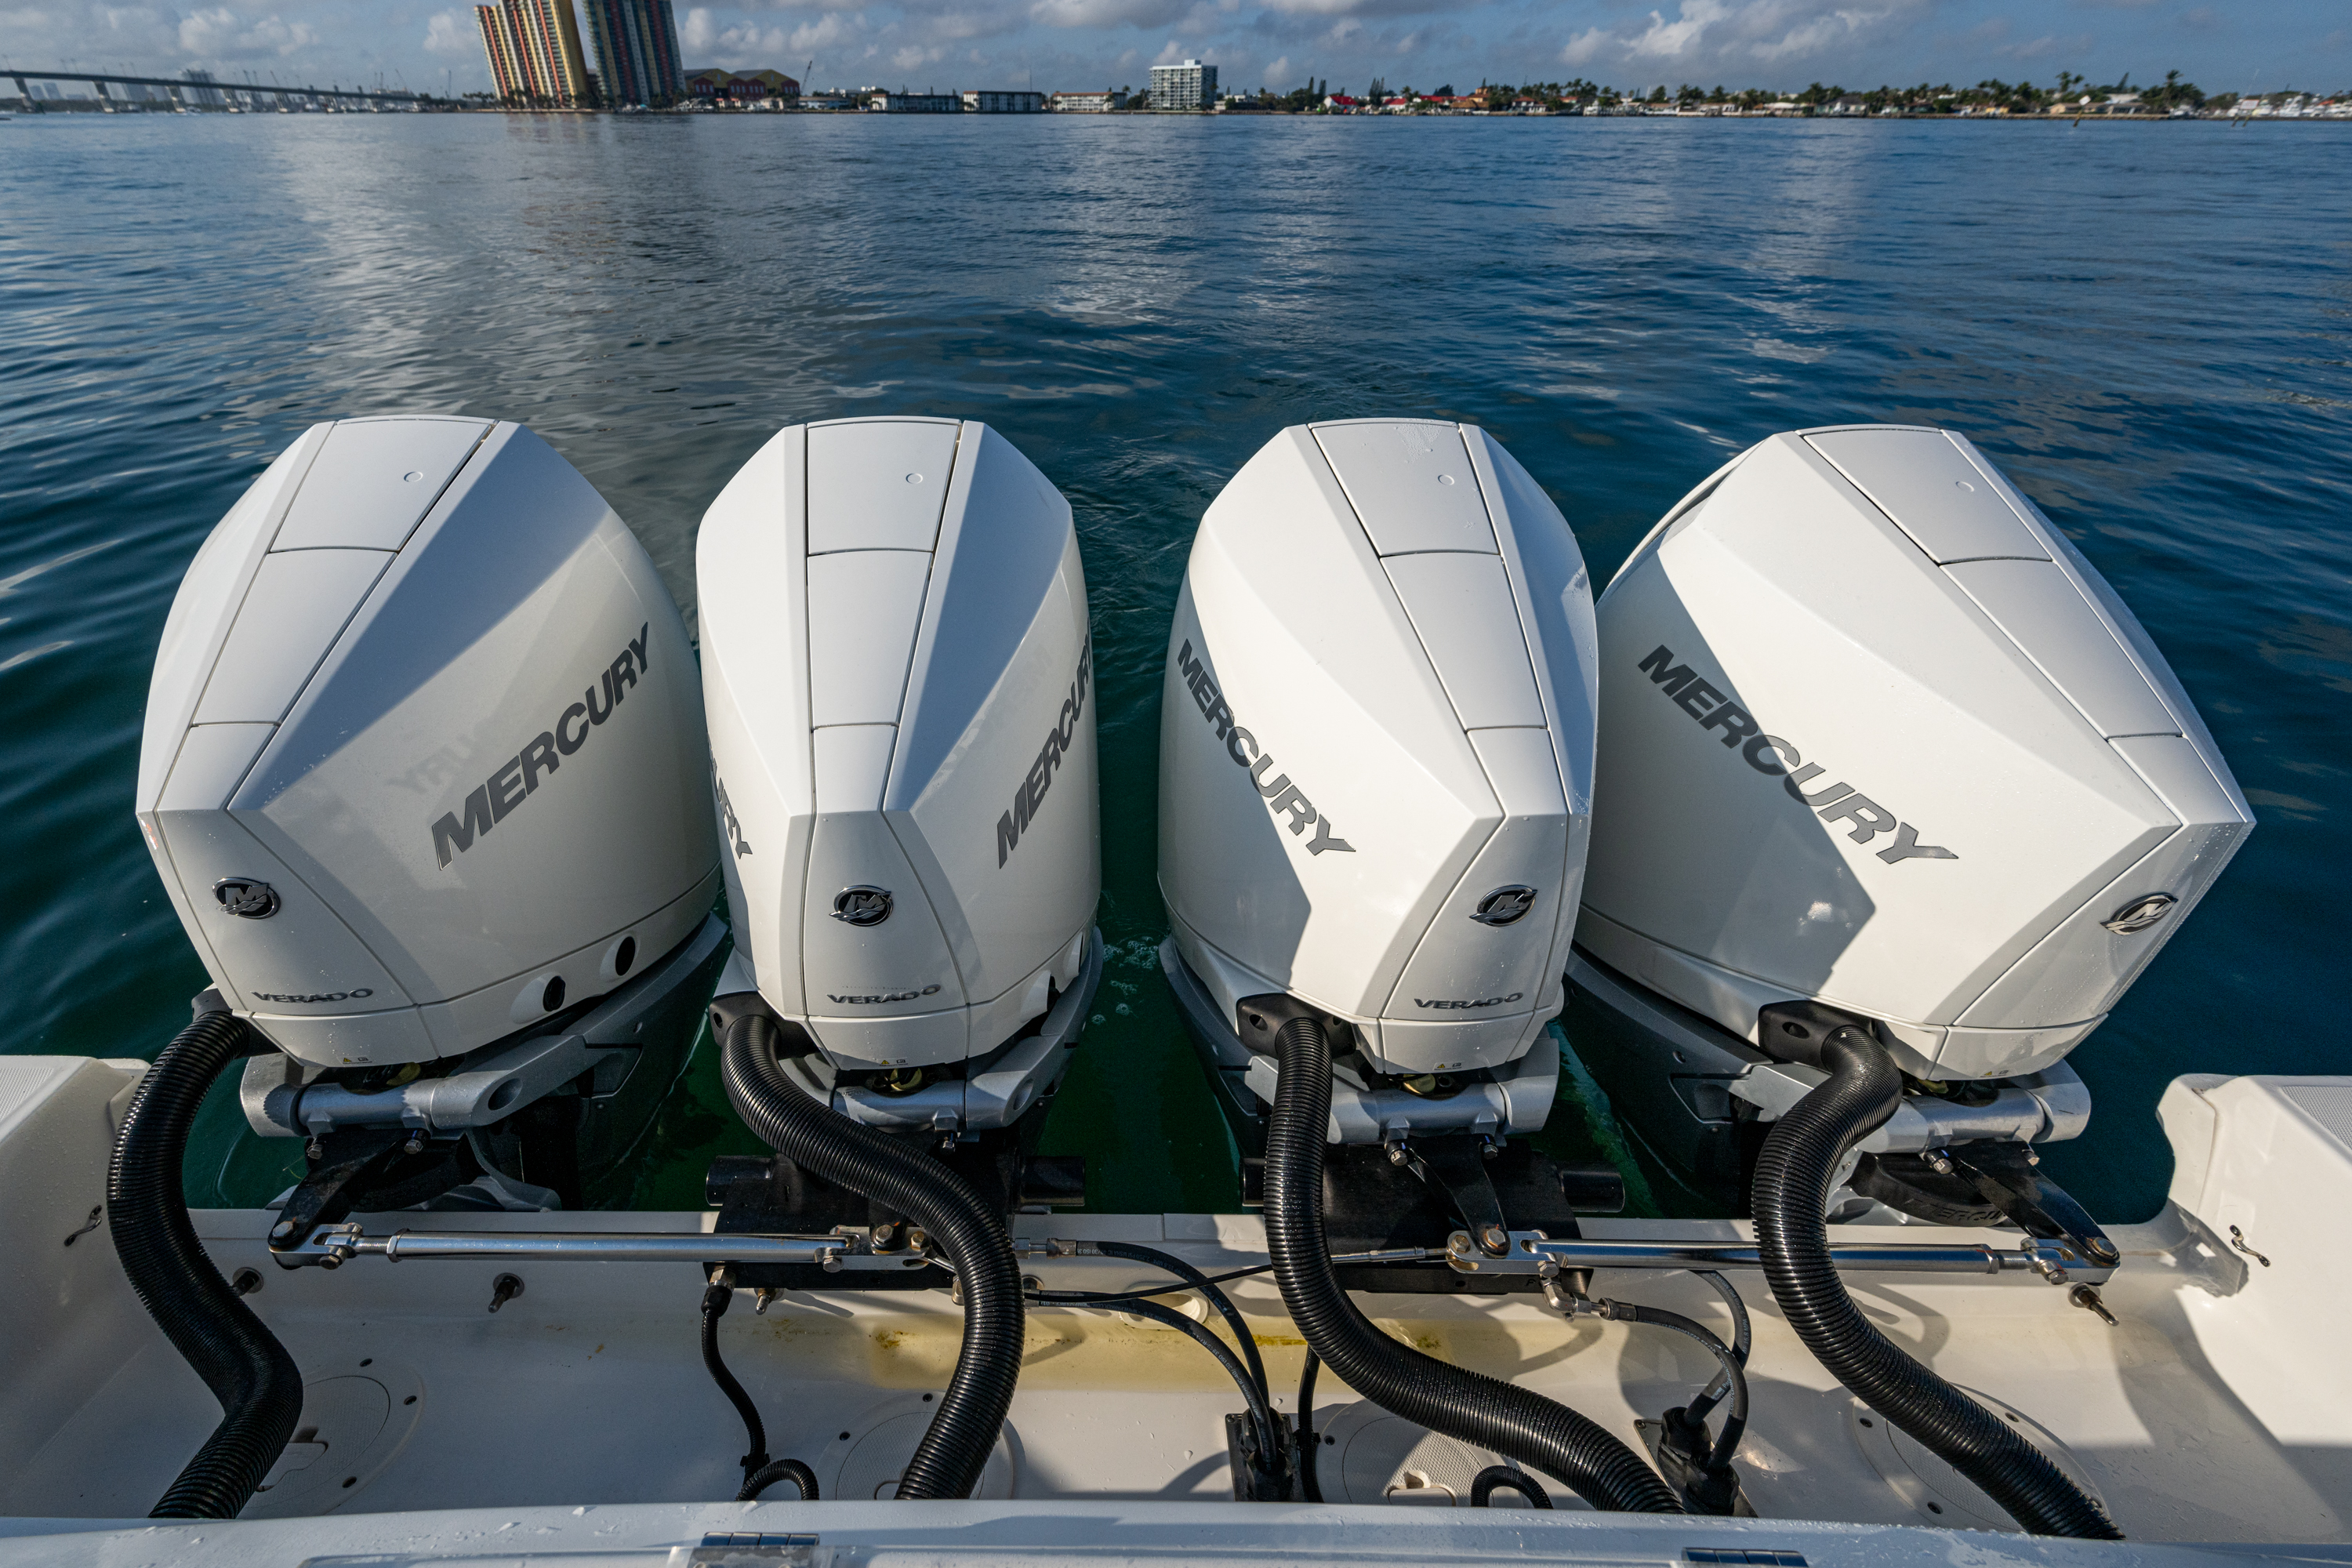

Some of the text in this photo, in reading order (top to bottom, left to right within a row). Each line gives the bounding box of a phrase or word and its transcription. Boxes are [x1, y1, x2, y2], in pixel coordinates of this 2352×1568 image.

[431, 622, 649, 871] MERCURY
[997, 616, 1091, 869] MERCURY
[1177, 638, 1356, 856] MERCURY
[1637, 644, 1959, 865] MERCURY
[252, 989, 373, 1004] VERADO
[826, 985, 941, 1005] VERADO
[1414, 993, 1523, 1010] VERADO
[1218, 1355, 1228, 1364] ISO
